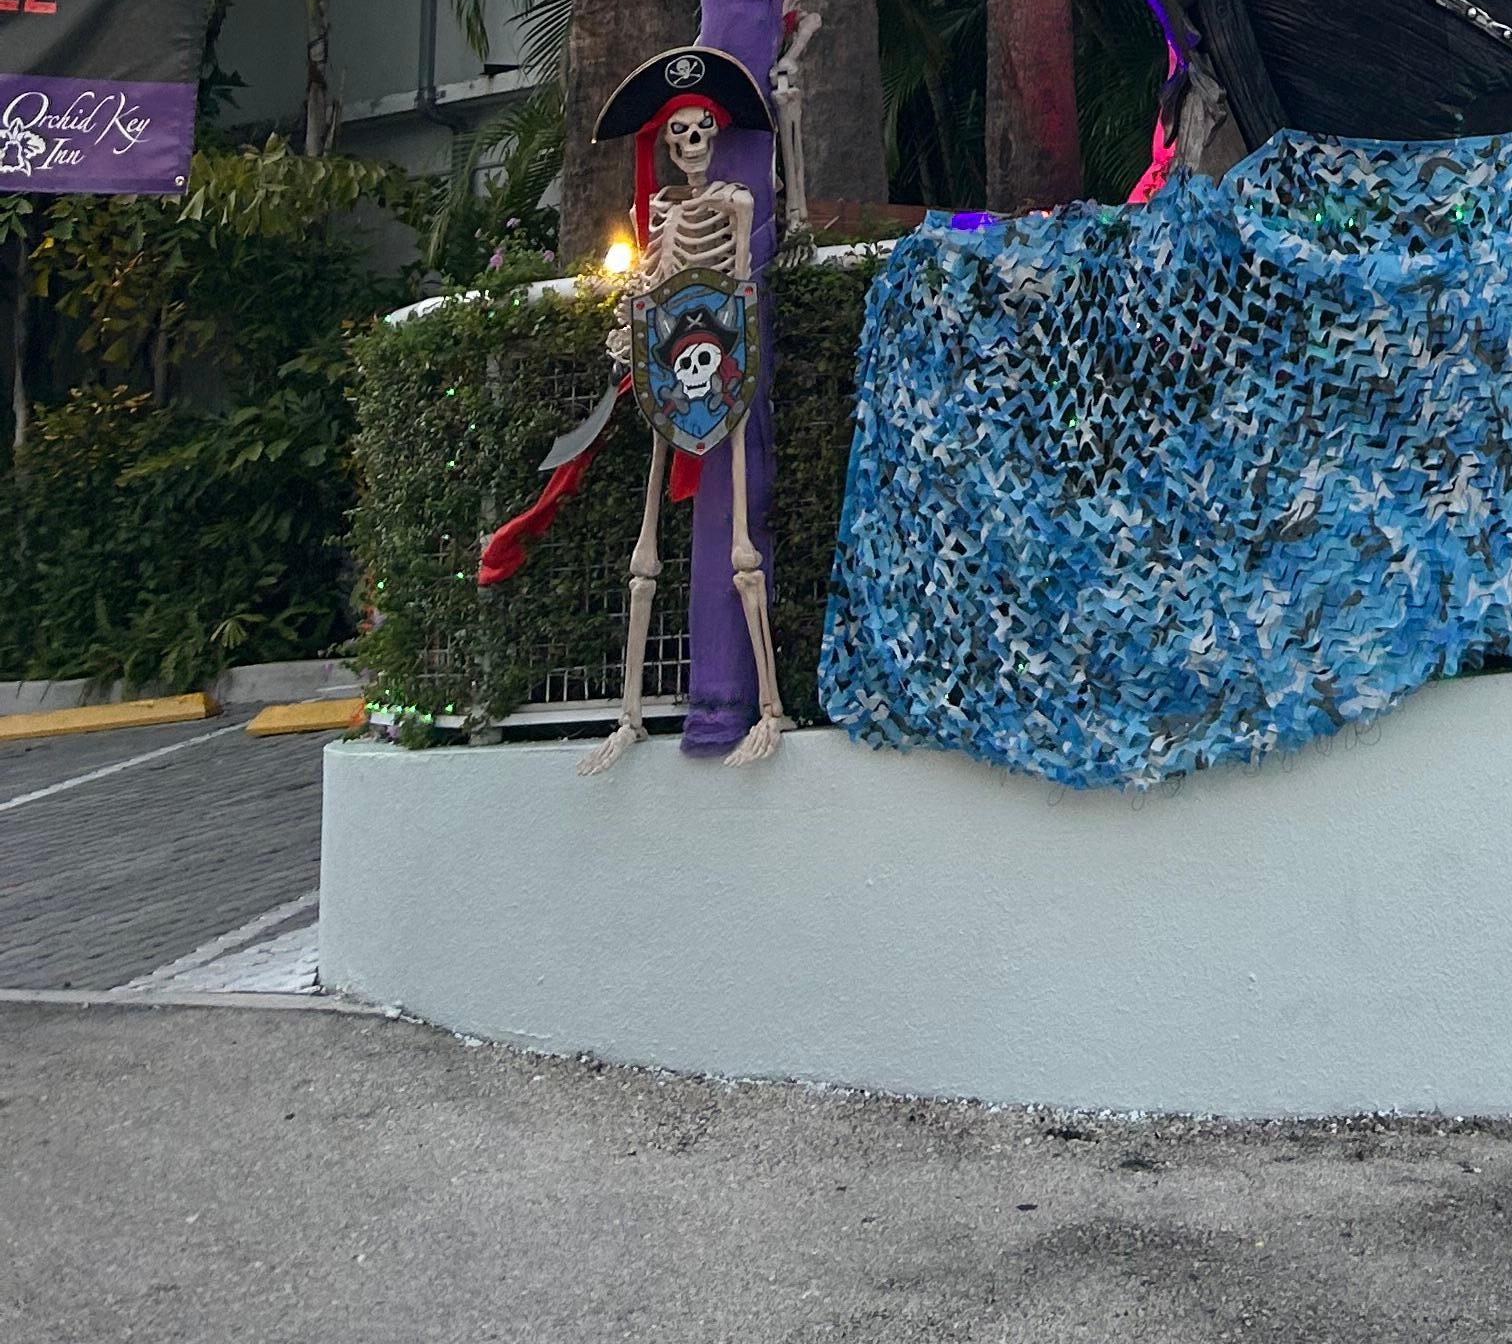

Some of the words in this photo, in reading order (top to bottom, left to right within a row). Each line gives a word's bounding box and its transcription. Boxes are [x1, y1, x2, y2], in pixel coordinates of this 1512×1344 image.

[3, 91, 115, 134] Orchid
[94, 91, 151, 155] Key
[34, 137, 85, 170] Inn
